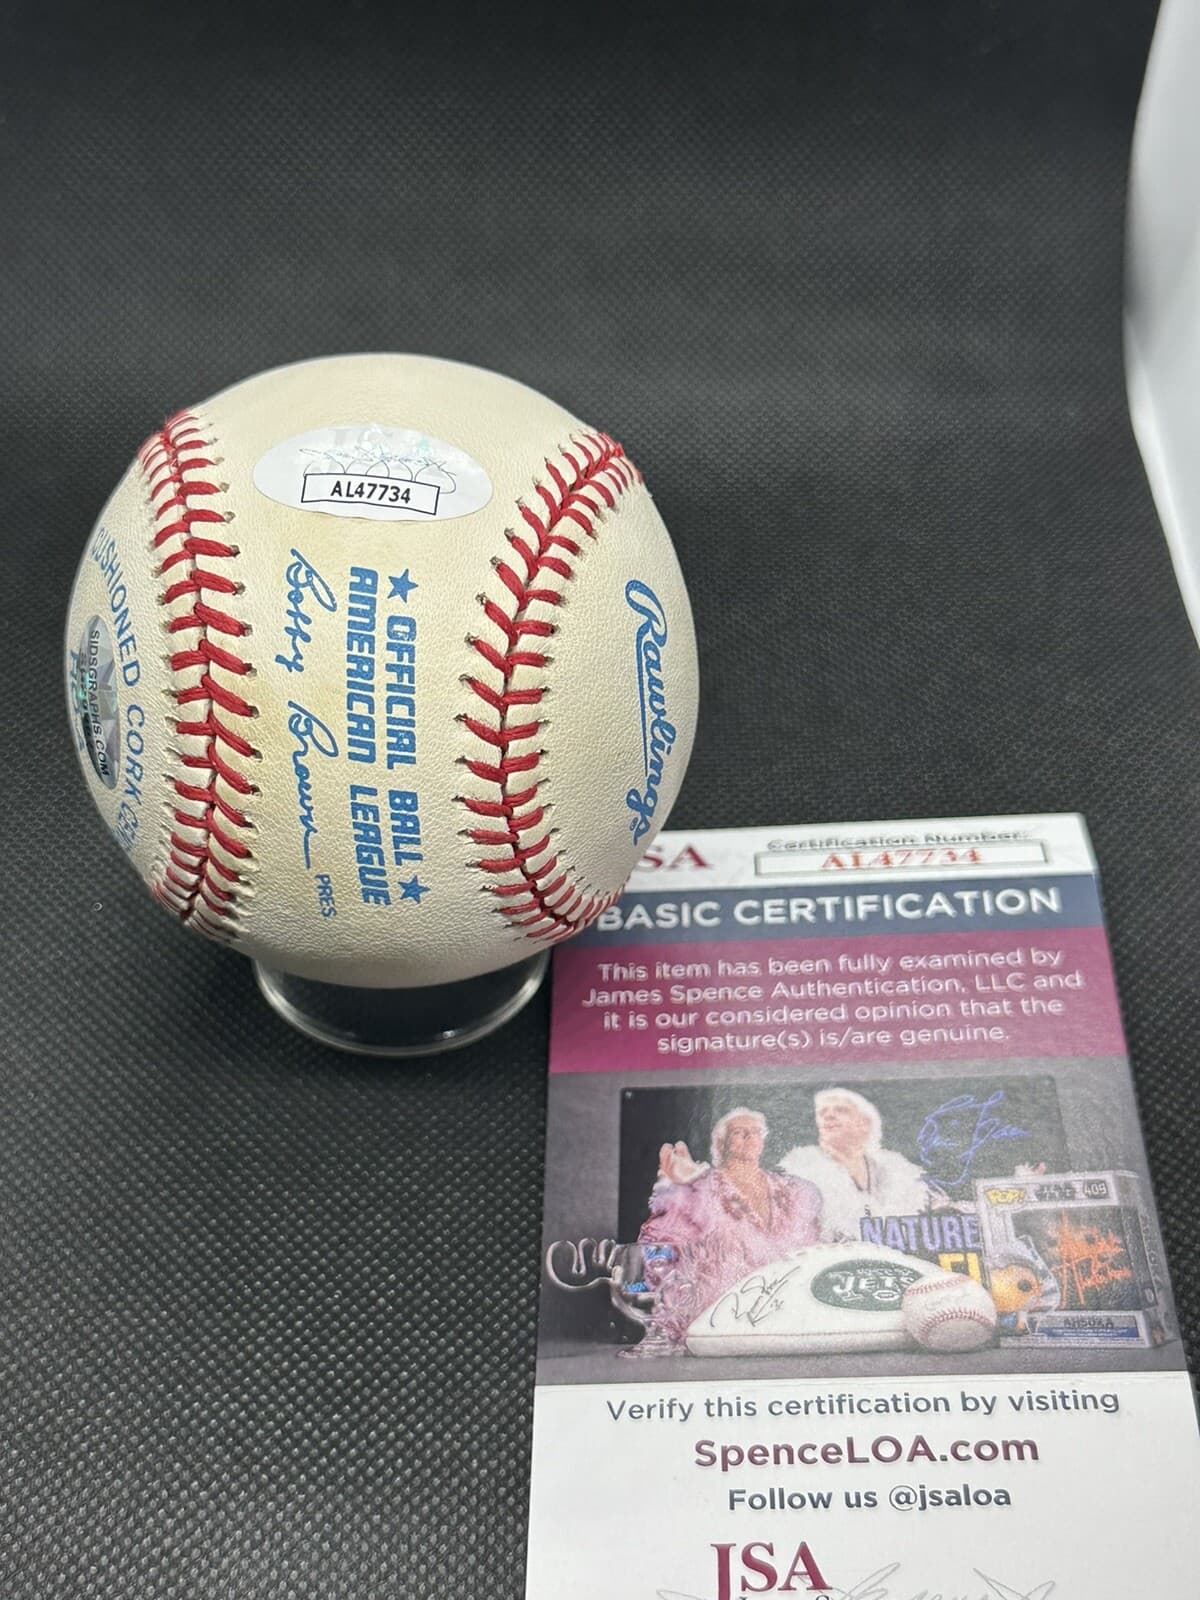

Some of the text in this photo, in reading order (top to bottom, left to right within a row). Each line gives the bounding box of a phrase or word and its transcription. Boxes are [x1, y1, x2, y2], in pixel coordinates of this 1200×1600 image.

[330, 480, 411, 504] AL47734
[90, 629, 111, 777] SIDSGRAPHS.COM
[624, 579, 677, 847] Rawlings
[123, 703, 146, 805] CORK
[346, 566, 392, 906] AMERICAN LEAGUE
[385, 614, 424, 867] OFFICIAL BALL
[634, 840, 715, 873] SA
[596, 887, 1063, 932] BASIC CERTIFICATION
[597, 947, 1063, 982] This item has been fully examined by
[581, 986, 664, 1008] James
[669, 983, 763, 1006] Spence
[974, 971, 1027, 992] LLC
[1033, 969, 1084, 990] and
[603, 997, 1065, 1031] it is our considered opinion that the
[657, 1025, 1010, 1057] signature(s) is/are genuine.
[861, 1212, 981, 1251] NATURE
[607, 1389, 1119, 1422] Verify this certification by visiting
[695, 1434, 1040, 1472] SpenceLOA.com
[728, 1484, 1011, 1511] Follow us @jsaloa
[710, 1541, 833, 1600] JSA
